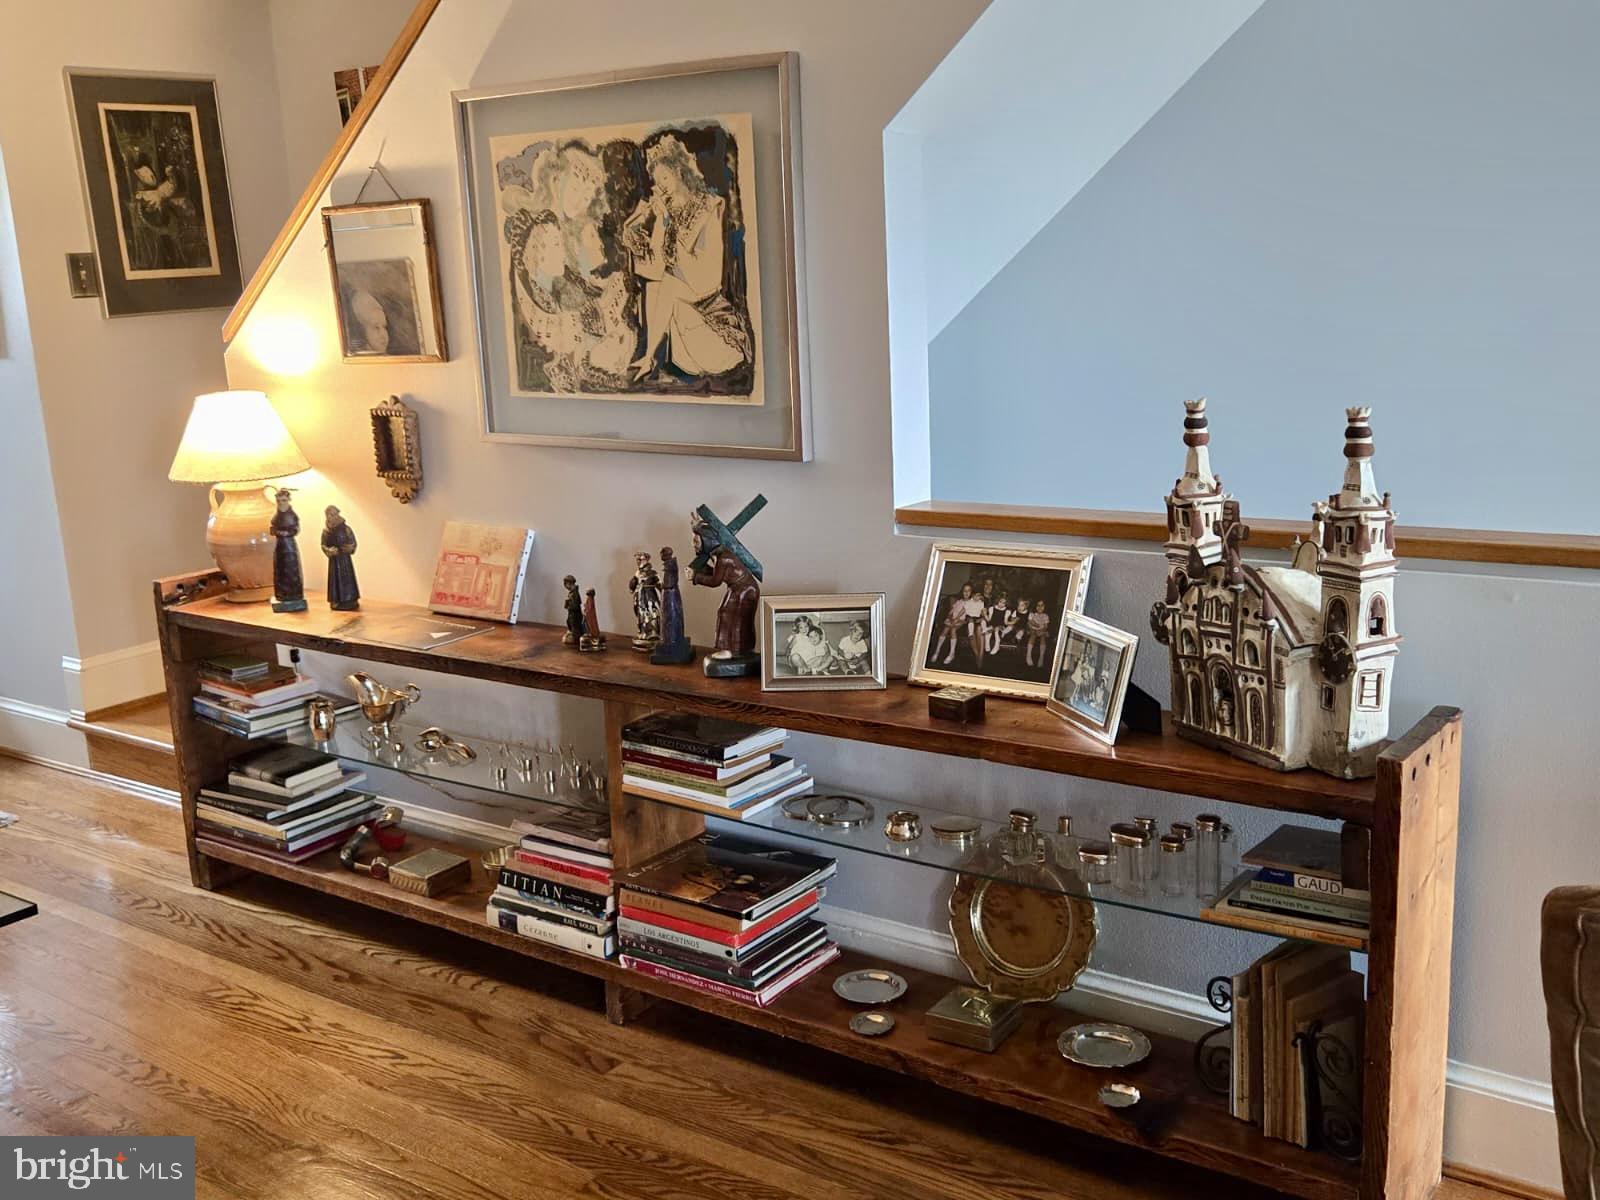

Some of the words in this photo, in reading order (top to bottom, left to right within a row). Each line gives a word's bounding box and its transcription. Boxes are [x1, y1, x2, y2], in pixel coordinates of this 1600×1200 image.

[501, 871, 562, 900] TITIAN
[625, 939, 663, 955] TANGO
[643, 927, 656, 938] LOS
[658, 931, 701, 950] ARGENTINOS
